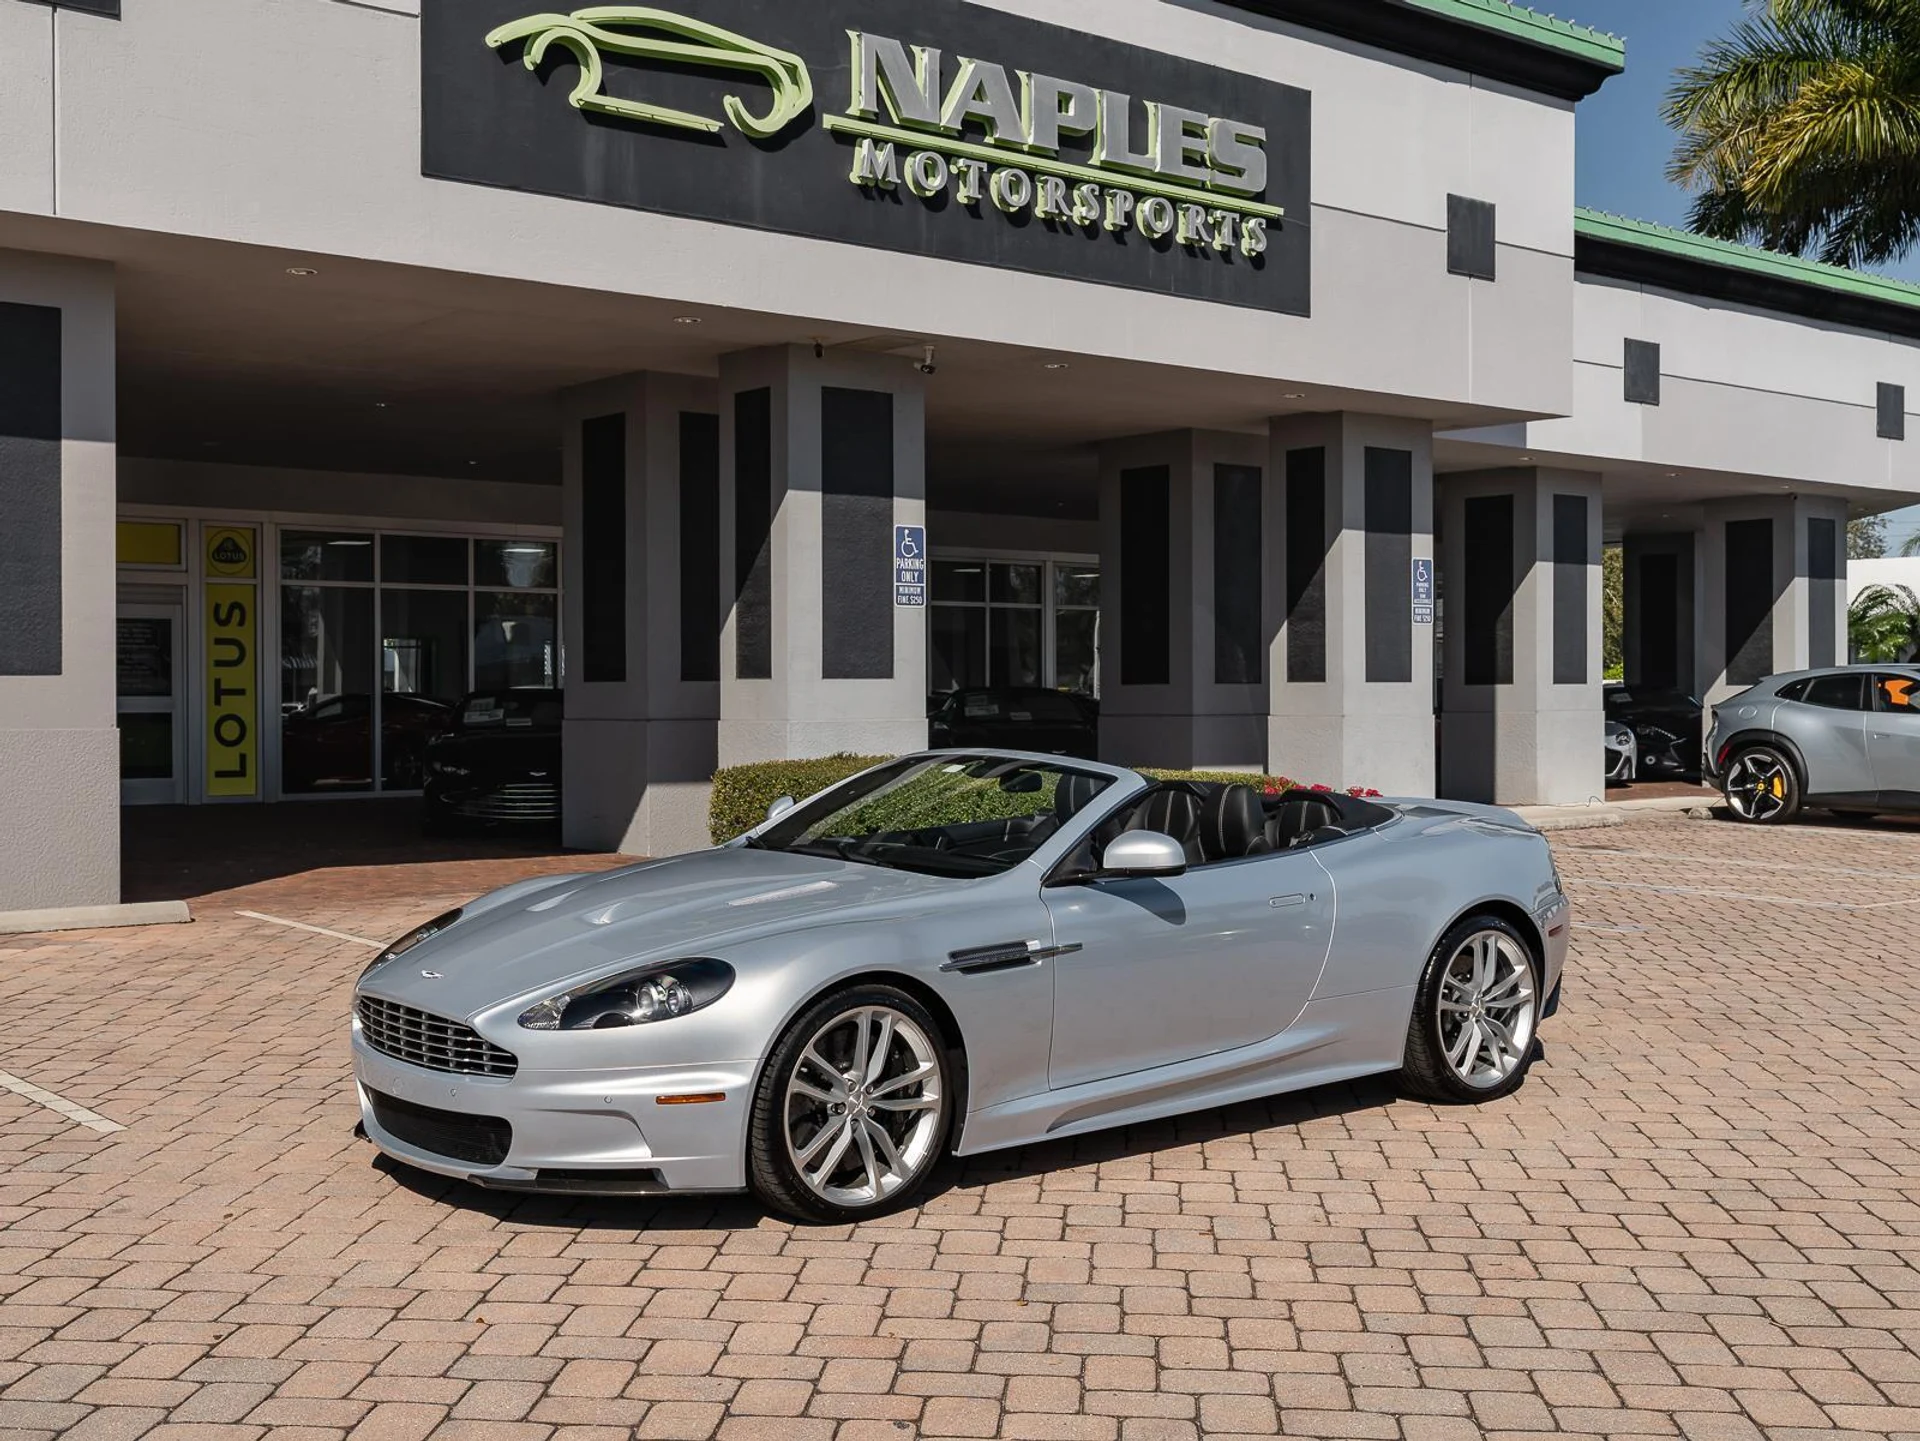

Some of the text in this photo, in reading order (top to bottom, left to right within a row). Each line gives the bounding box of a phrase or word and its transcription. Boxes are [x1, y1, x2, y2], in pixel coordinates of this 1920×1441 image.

[846, 29, 1267, 196] NAPLES
[850, 138, 1267, 256] MOTORSPORTS
[214, 551, 245, 561] LOTUS
[897, 558, 924, 570] PARKING
[902, 571, 919, 582] ONLY
[213, 600, 247, 778] LOTUS
